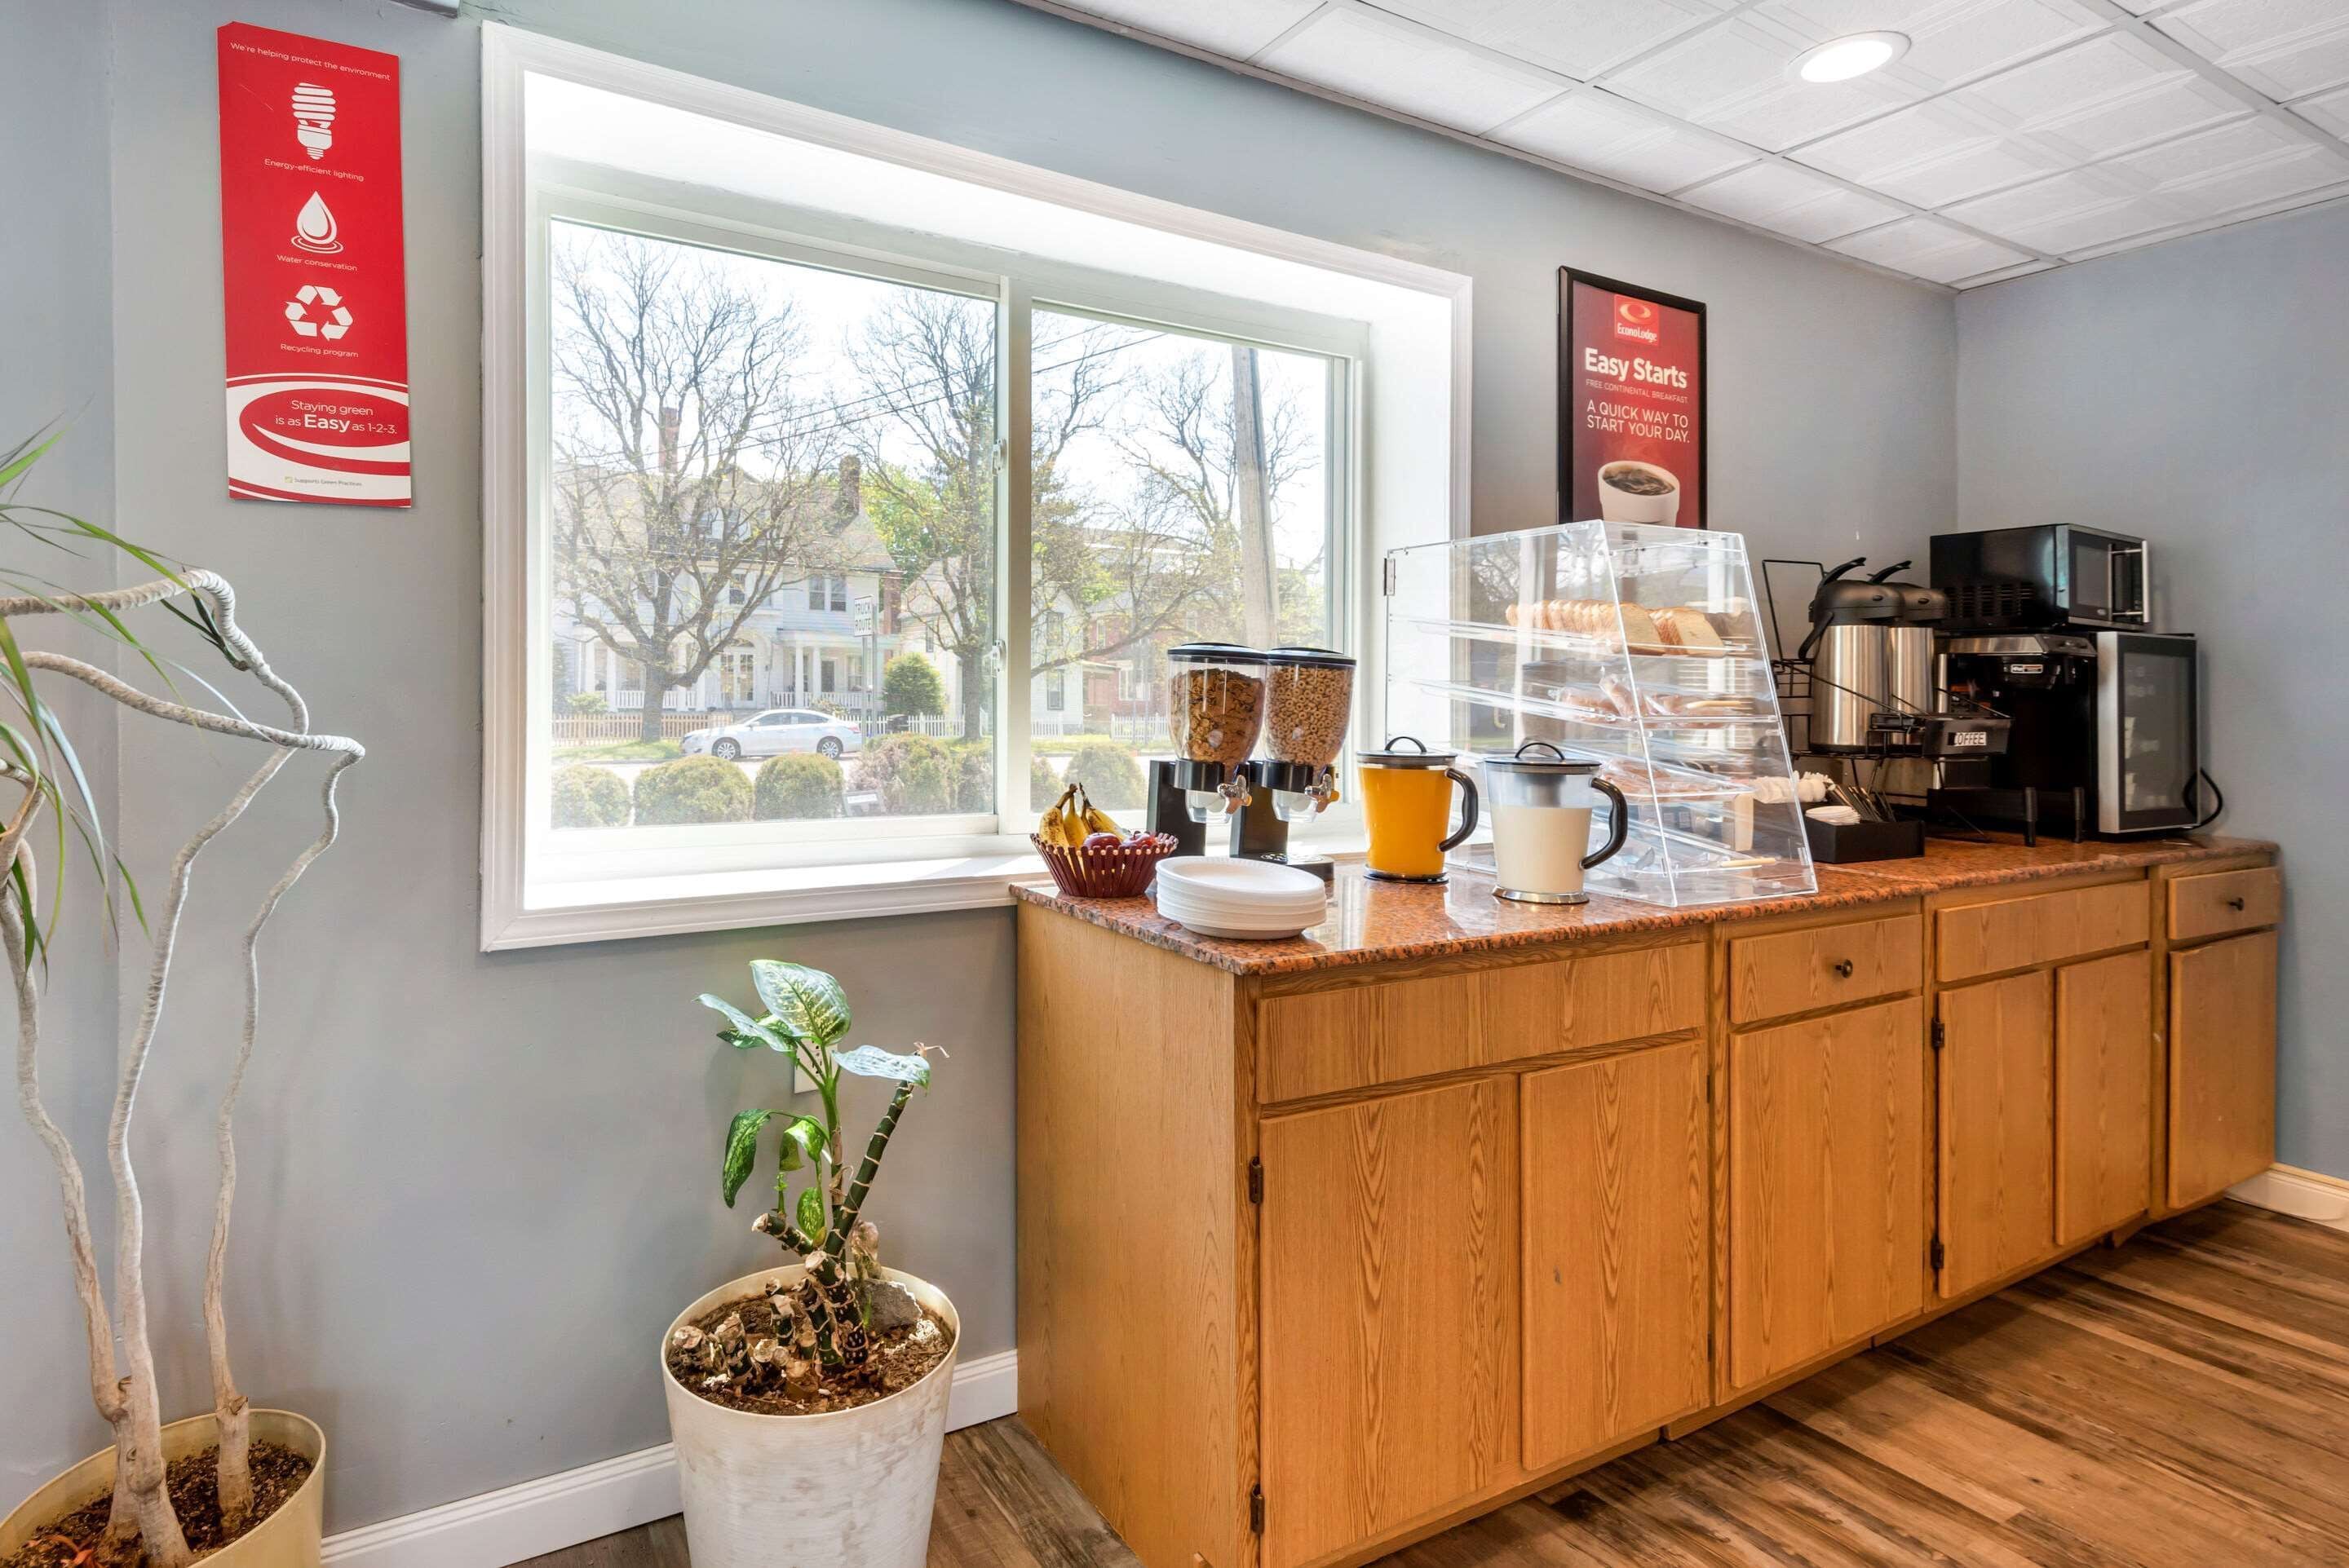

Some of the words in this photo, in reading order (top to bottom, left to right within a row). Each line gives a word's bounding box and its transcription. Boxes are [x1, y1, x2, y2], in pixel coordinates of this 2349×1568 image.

[230, 42, 256, 53] We're
[258, 47, 290, 61] helping
[291, 53, 322, 67] protect
[324, 61, 338, 69] the
[339, 65, 391, 81] environment
[264, 158, 331, 176] Energy-efficient
[333, 170, 365, 182] lighting
[276, 254, 303, 264] Water
[304, 258, 357, 272] conservation
[281, 343, 321, 356] Recycling
[323, 348, 359, 358] program
[1585, 347, 1630, 382] Easy
[1633, 357, 1688, 389] Starts
[1586, 378, 1604, 389] FREE
[1604, 382, 1650, 398] CONTINENTAL
[291, 400, 337, 415] Staying
[339, 406, 374, 416] green
[1587, 400, 1596, 413] A
[1599, 402, 1639, 420] QUICK
[1643, 409, 1670, 425] WAY
[1673, 413, 1688, 428] TO
[276, 415, 285, 425] is
[288, 418, 301, 426] as
[304, 414, 351, 433] Easy
[352, 422, 365, 431] as
[368, 422, 397, 434] 1-2-3.
[1586, 414, 1625, 433] START
[1628, 422, 1662, 439] YOUR
[1666, 428, 1690, 443] DAY.
[854, 601, 872, 615] TRUCK
[854, 617, 871, 632] ROUTE
